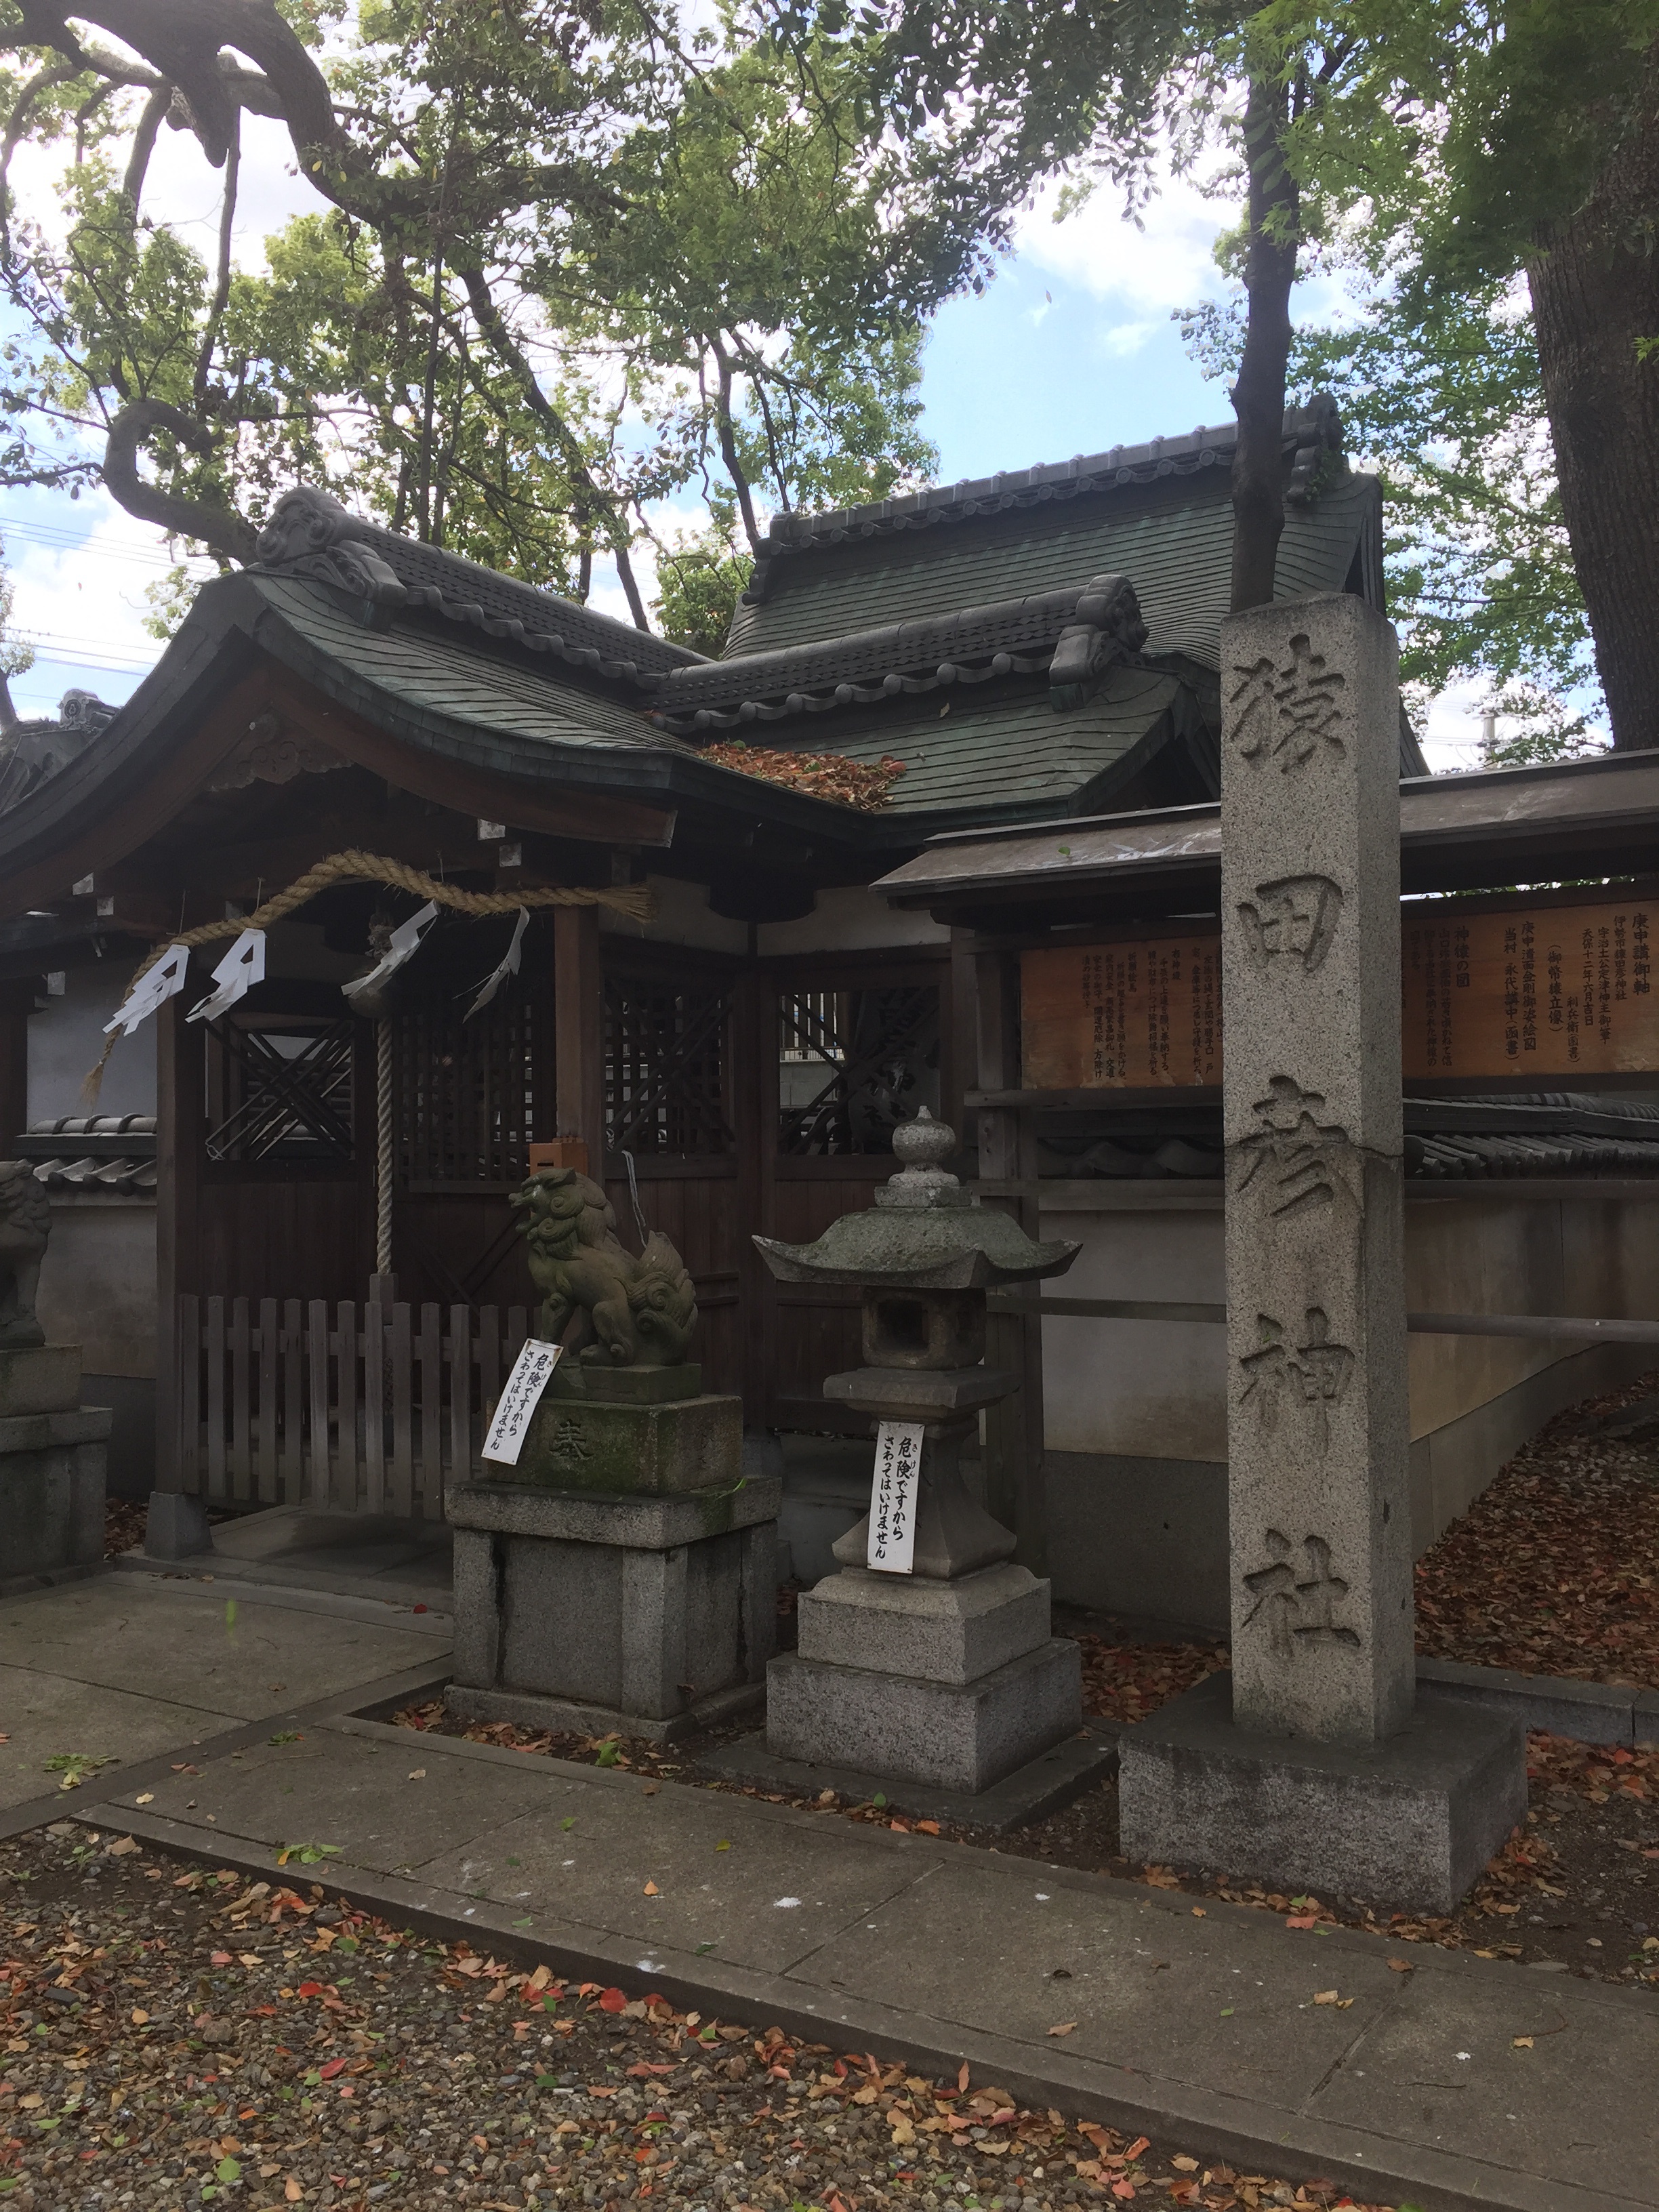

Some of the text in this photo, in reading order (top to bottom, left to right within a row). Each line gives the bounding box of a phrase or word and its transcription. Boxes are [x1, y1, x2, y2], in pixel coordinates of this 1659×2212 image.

[1581, 928, 1595, 1027] 天保十二年六月吉日
[490, 1350, 535, 1451] さわってはいけません
[509, 1352, 550, 1437] 危険ですから
[874, 1435, 895, 1560] さわってはいけません
[892, 1435, 912, 1542] 危険ですから
